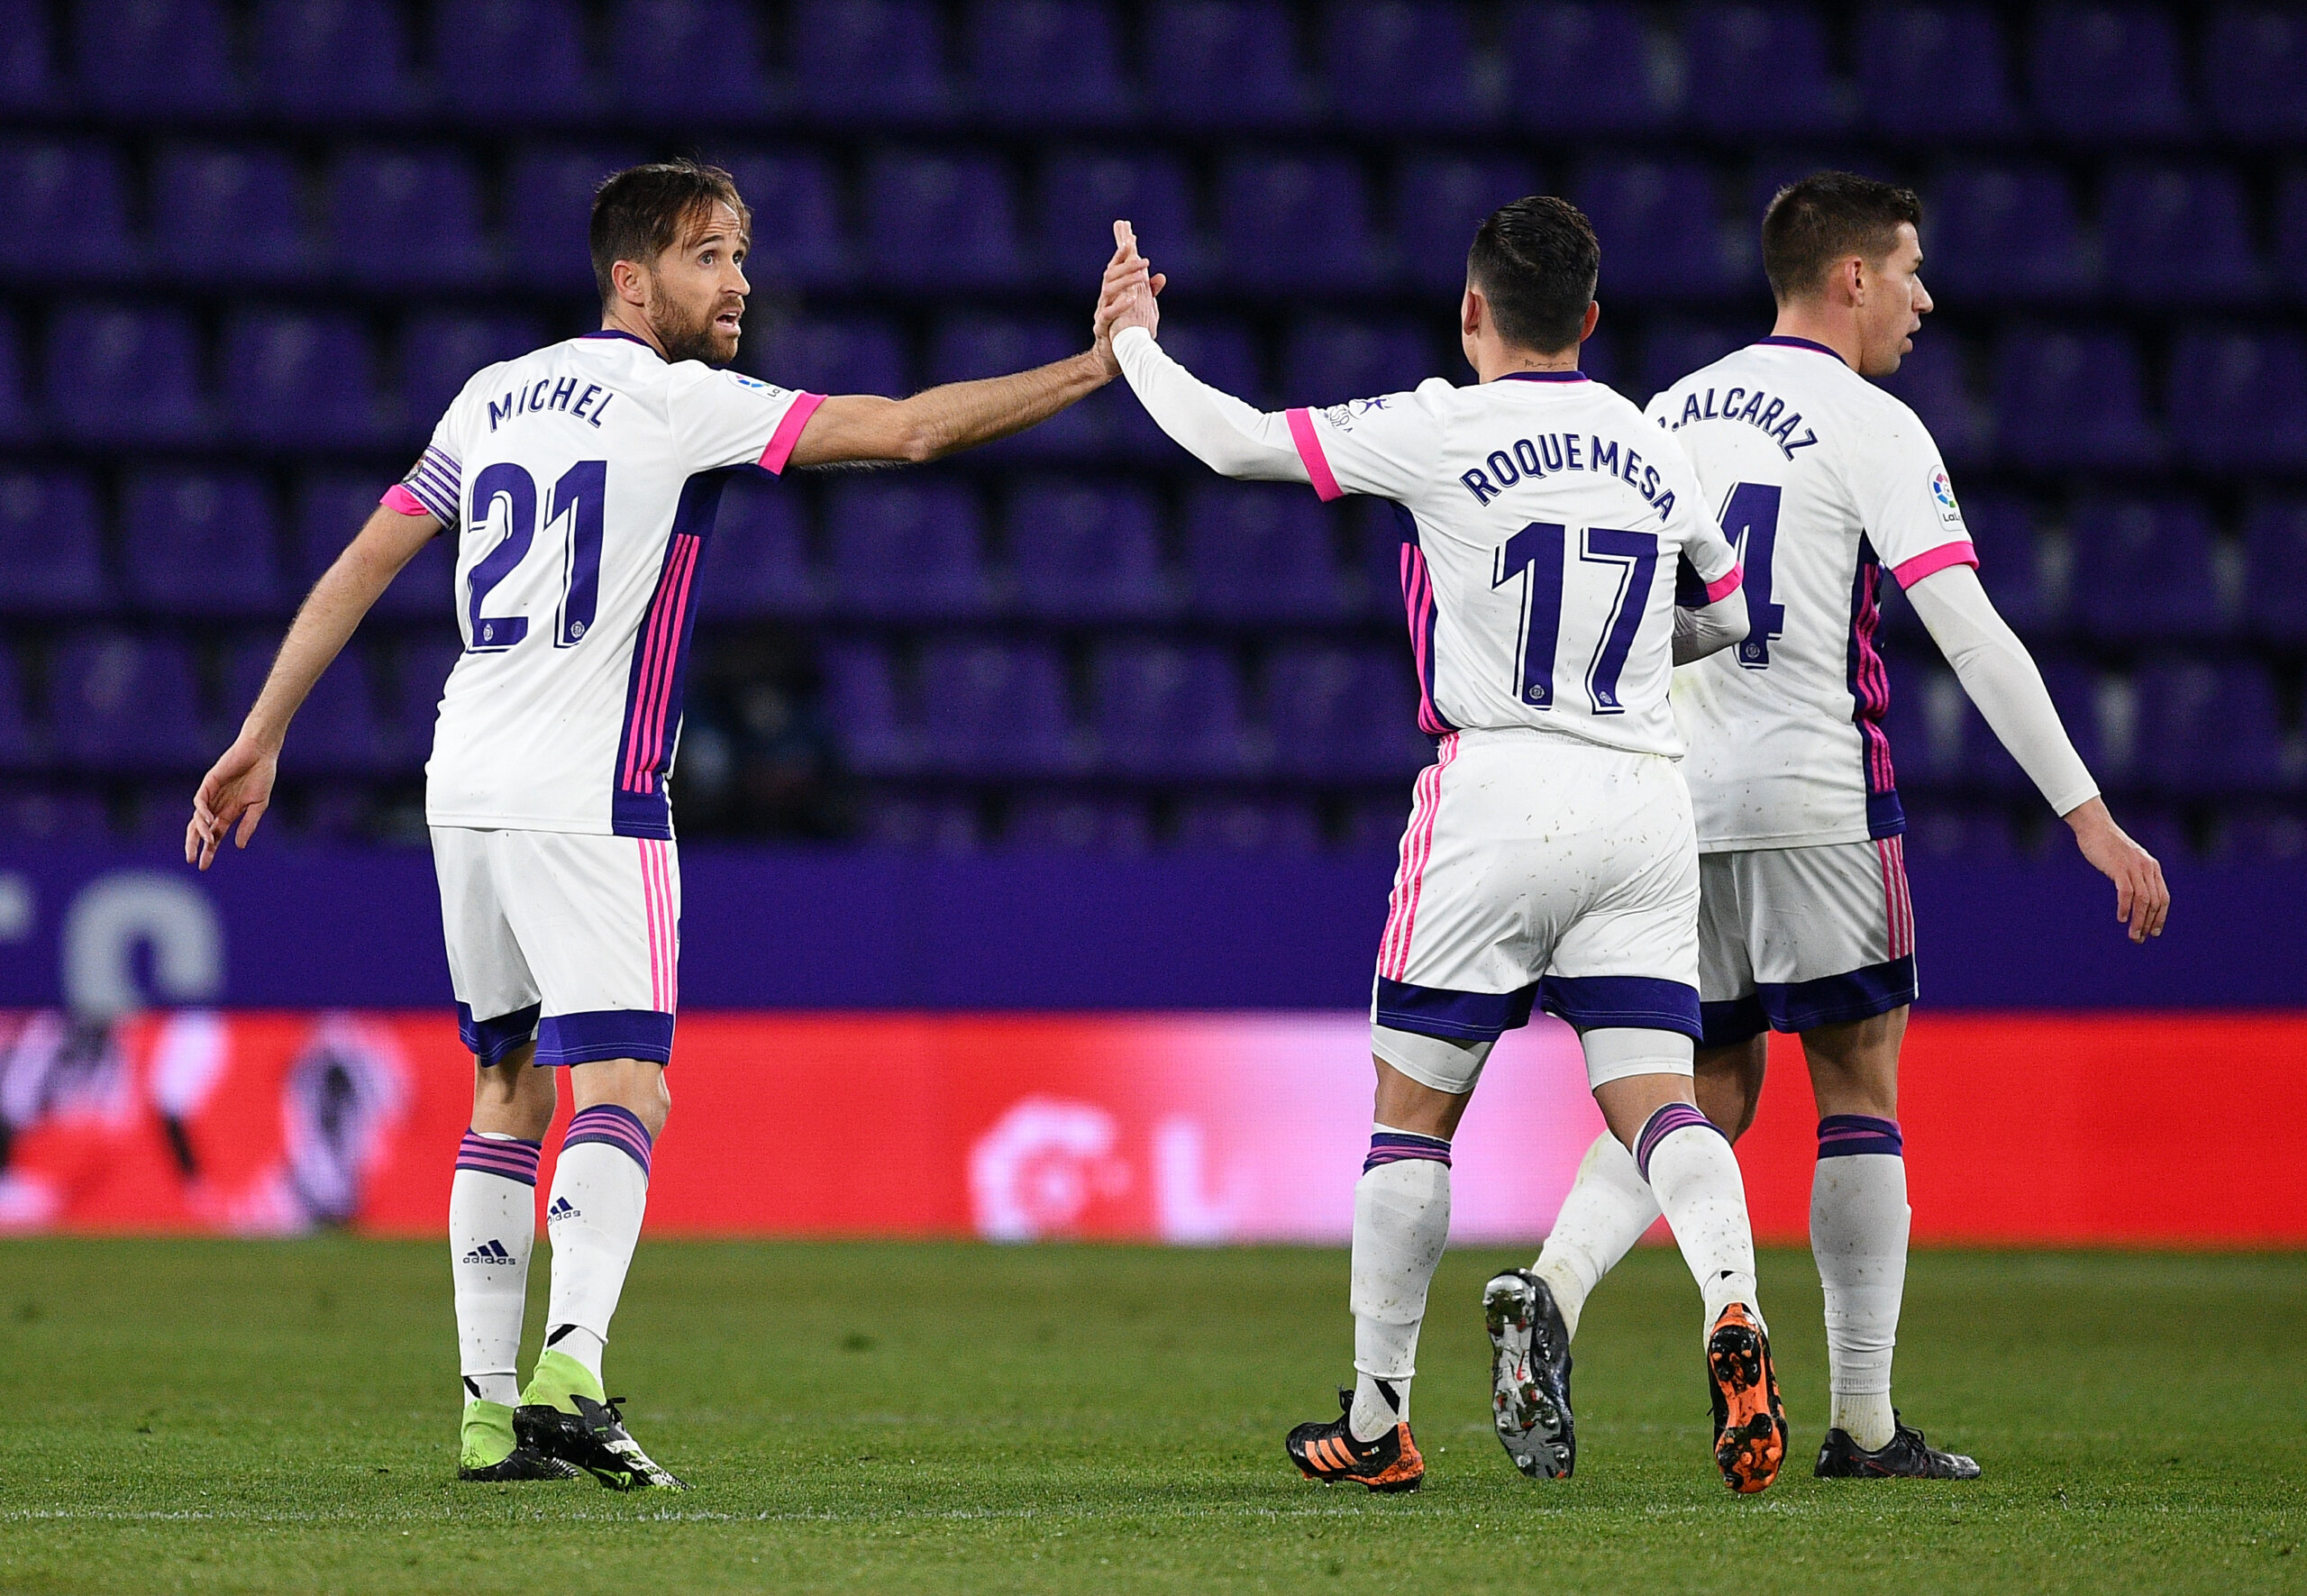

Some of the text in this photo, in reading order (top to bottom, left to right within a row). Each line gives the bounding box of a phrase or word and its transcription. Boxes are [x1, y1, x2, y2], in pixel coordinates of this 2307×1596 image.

[1657, 387, 1819, 462] .ALCARAZ
[1459, 433, 1676, 524] ROQUE MESA
[465, 460, 607, 654] 21
[1491, 521, 1658, 716] 17
[462, 1255, 516, 1266] adidas
